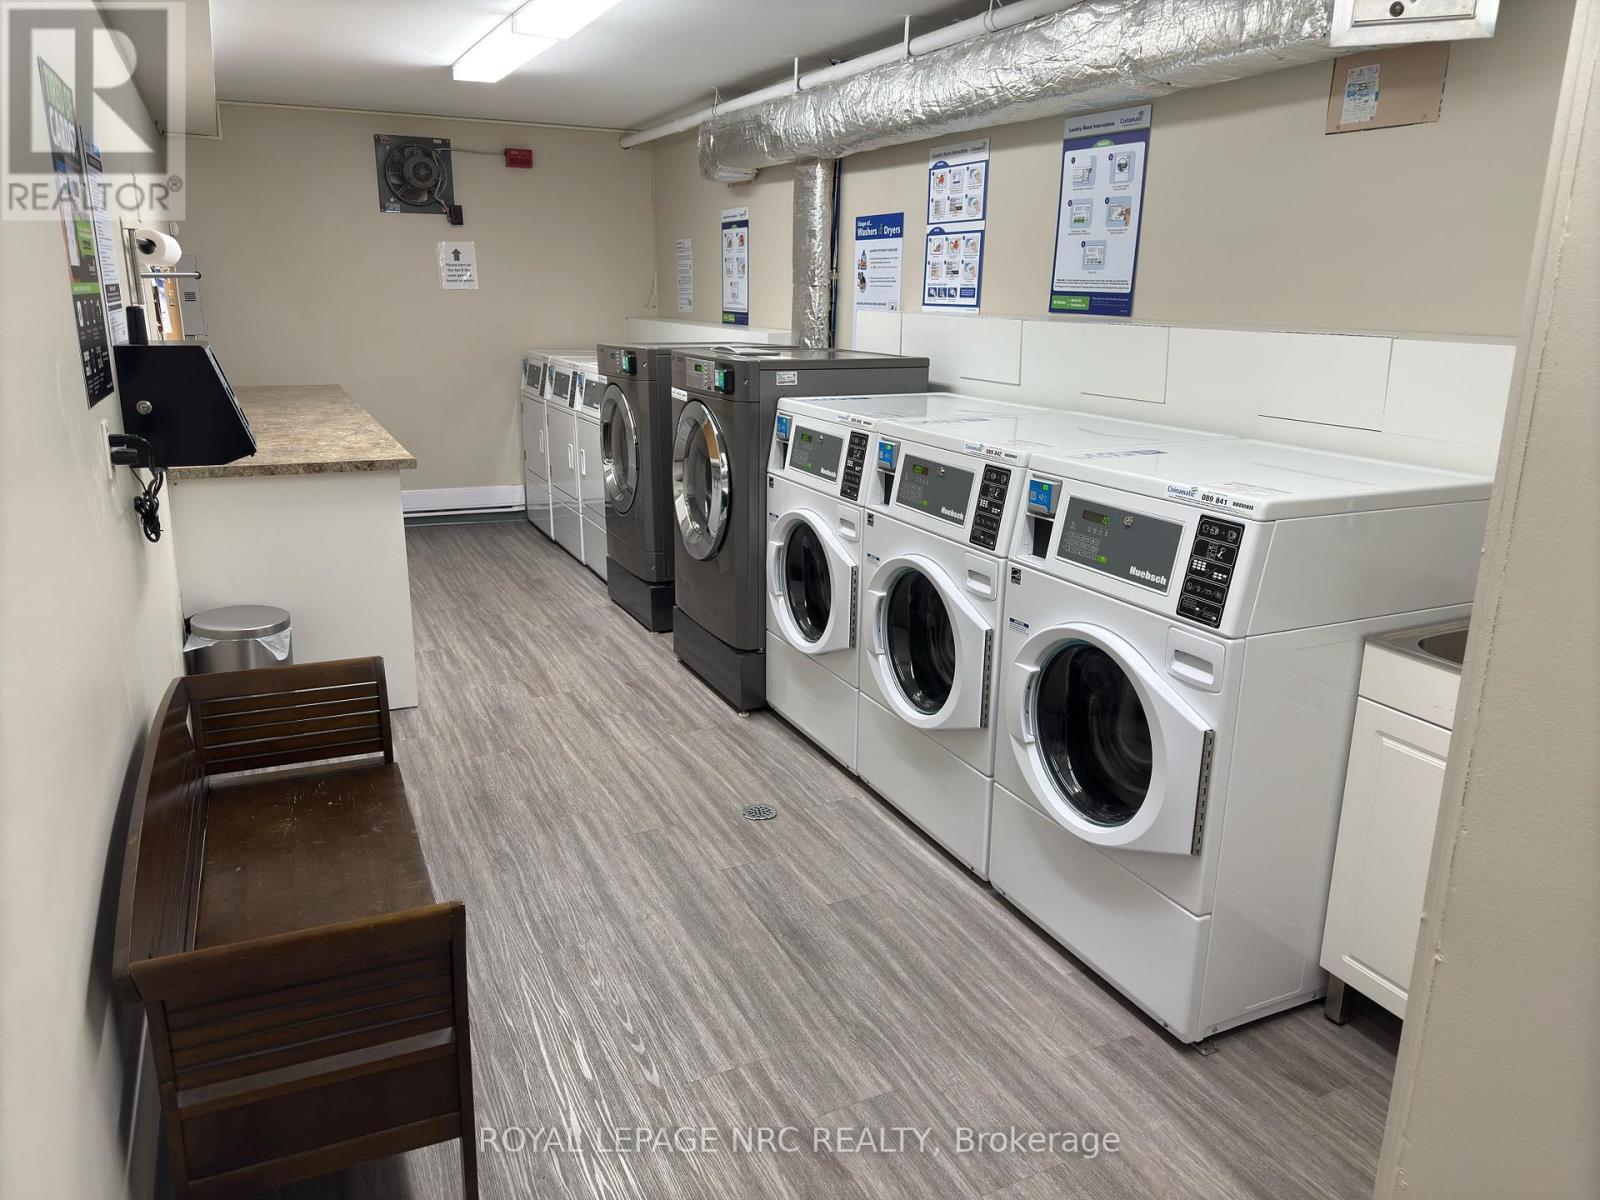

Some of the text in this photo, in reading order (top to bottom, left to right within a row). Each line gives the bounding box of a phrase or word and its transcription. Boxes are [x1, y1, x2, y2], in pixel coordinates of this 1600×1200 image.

[857, 227, 878, 237] Washers
[883, 225, 901, 237] Dryers
[1167, 485, 1196, 498] Coinamatic
[1201, 493, 1214, 503] 089
[1215, 496, 1228, 506] 841
[940, 505, 965, 521] Huebsch
[1129, 565, 1167, 586] Huebsch
